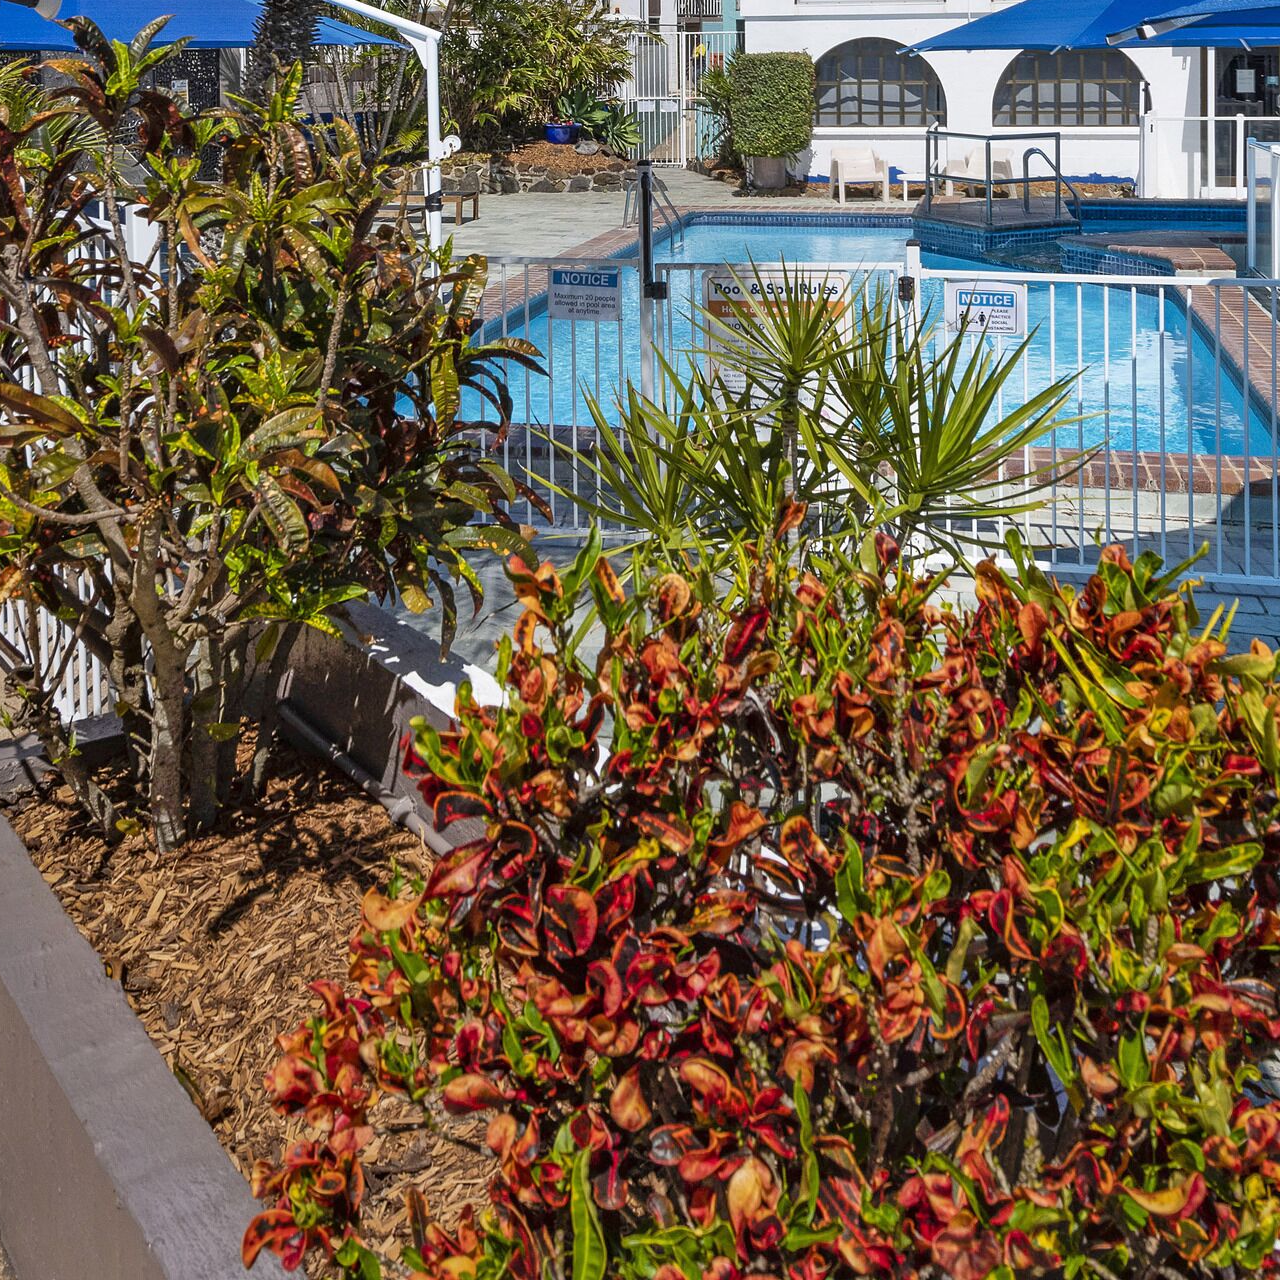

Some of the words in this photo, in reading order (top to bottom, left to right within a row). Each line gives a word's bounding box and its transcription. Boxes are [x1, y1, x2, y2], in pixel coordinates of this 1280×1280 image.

[561, 273, 609, 286] NOTICE
[714, 283, 743, 295] Poo
[751, 283, 761, 295] &
[799, 282, 838, 295] Rules
[554, 292, 584, 300] Maximum
[961, 293, 1012, 306] NOTICE
